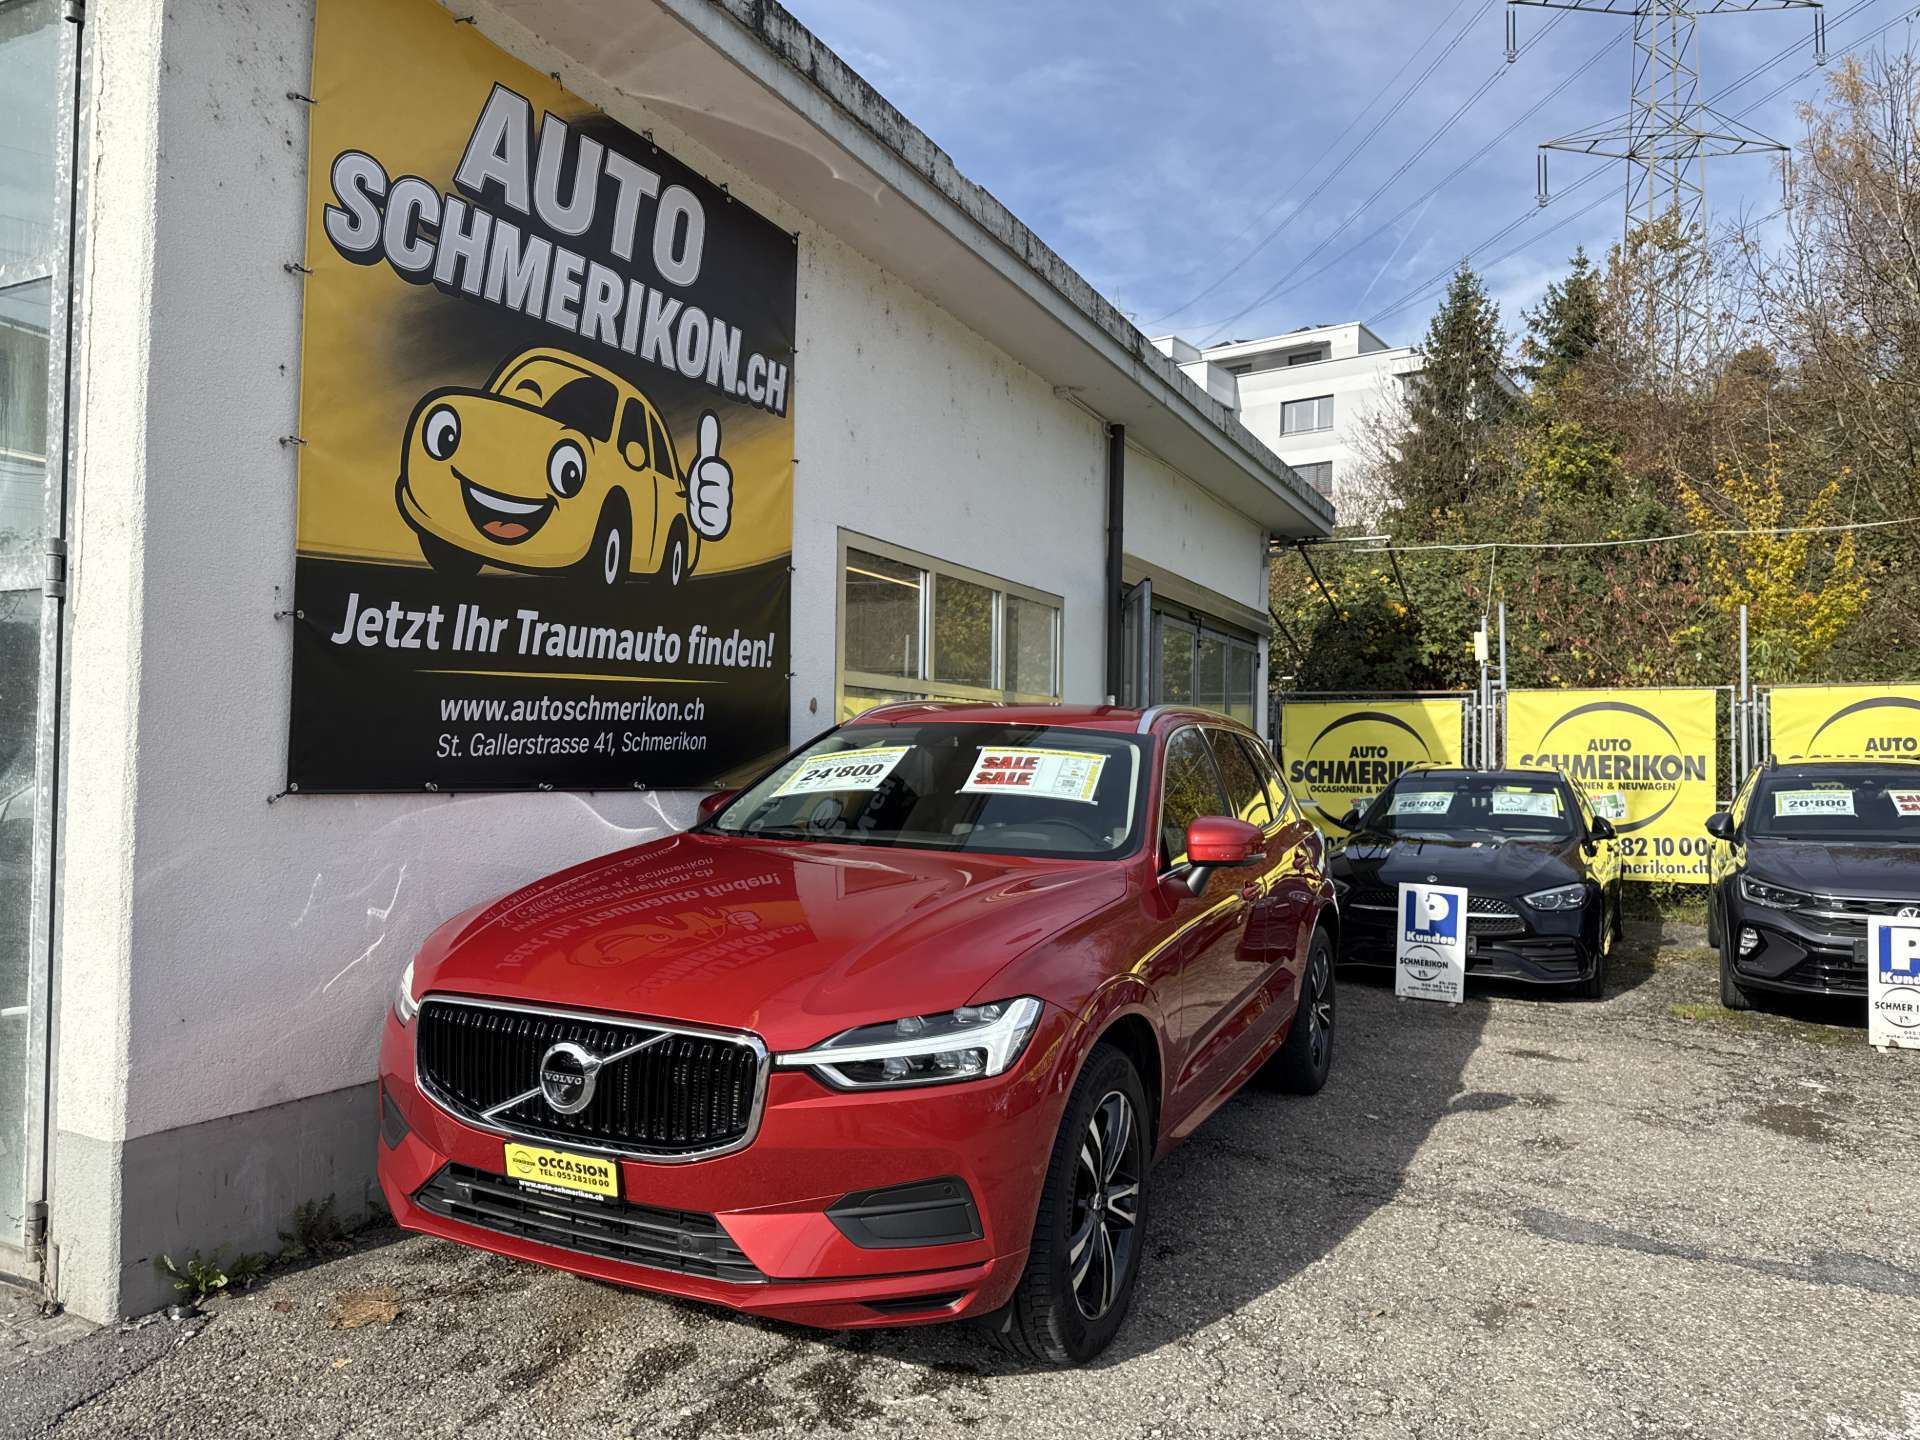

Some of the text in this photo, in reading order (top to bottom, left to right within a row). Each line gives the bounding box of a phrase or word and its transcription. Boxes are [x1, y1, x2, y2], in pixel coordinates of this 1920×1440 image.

[455, 82, 705, 287] AUTO
[325, 151, 787, 416] SCHMERIKON.CH
[331, 593, 775, 669] Jetzt Ihr Traumauto finden!
[440, 695, 705, 723] www.autoschmerikon.ch
[437, 731, 707, 758] St. Gallerstrasse 41, Schmerikon
[1588, 738, 1632, 752] AUTO
[1865, 737, 1918, 752] AUTO
[1349, 746, 1388, 759] AUTO
[981, 756, 1040, 770] SALE
[800, 763, 884, 782] 24'800
[973, 771, 1034, 786] SALE
[1290, 760, 1453, 785] SCHMERI
[1310, 785, 1363, 794] OCCASIONEN
[1618, 782, 1676, 791] NEUWAGEN
[1788, 800, 1847, 808] 20'800
[1618, 837, 1648, 857] 82
[1652, 837, 1674, 857] 10
[1406, 931, 1457, 946] Kunden
[1399, 957, 1449, 969] SCHMERIKON
[544, 1072, 582, 1085] VOLVO
[538, 1156, 608, 1179] OCCASION
[539, 1168, 556, 1178] TEL:
[519, 1179, 605, 1201] www.auto-schmerikon.ch
